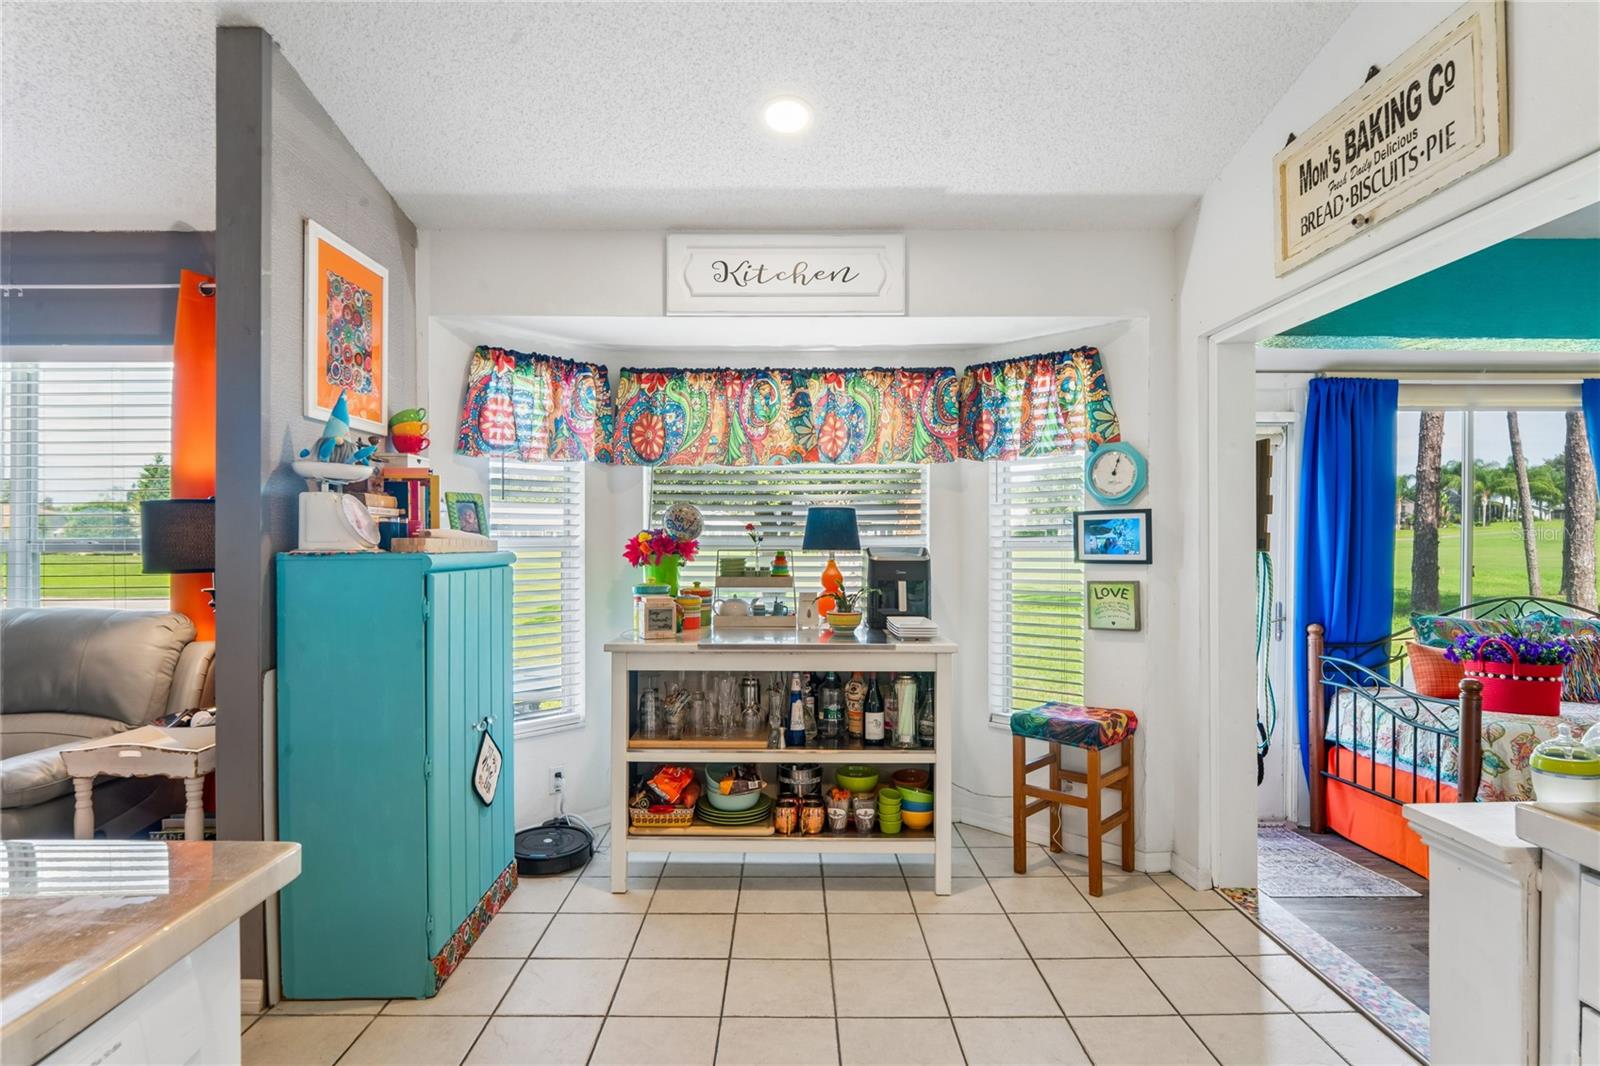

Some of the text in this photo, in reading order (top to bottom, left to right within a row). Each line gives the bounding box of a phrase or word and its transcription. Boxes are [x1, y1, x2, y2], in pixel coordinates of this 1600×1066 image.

[1344, 79, 1422, 164] BAKING
[1327, 127, 1419, 196] Fresh Daily Delicious
[711, 260, 860, 288] Kitchen
[1094, 587, 1130, 600] LOVE
